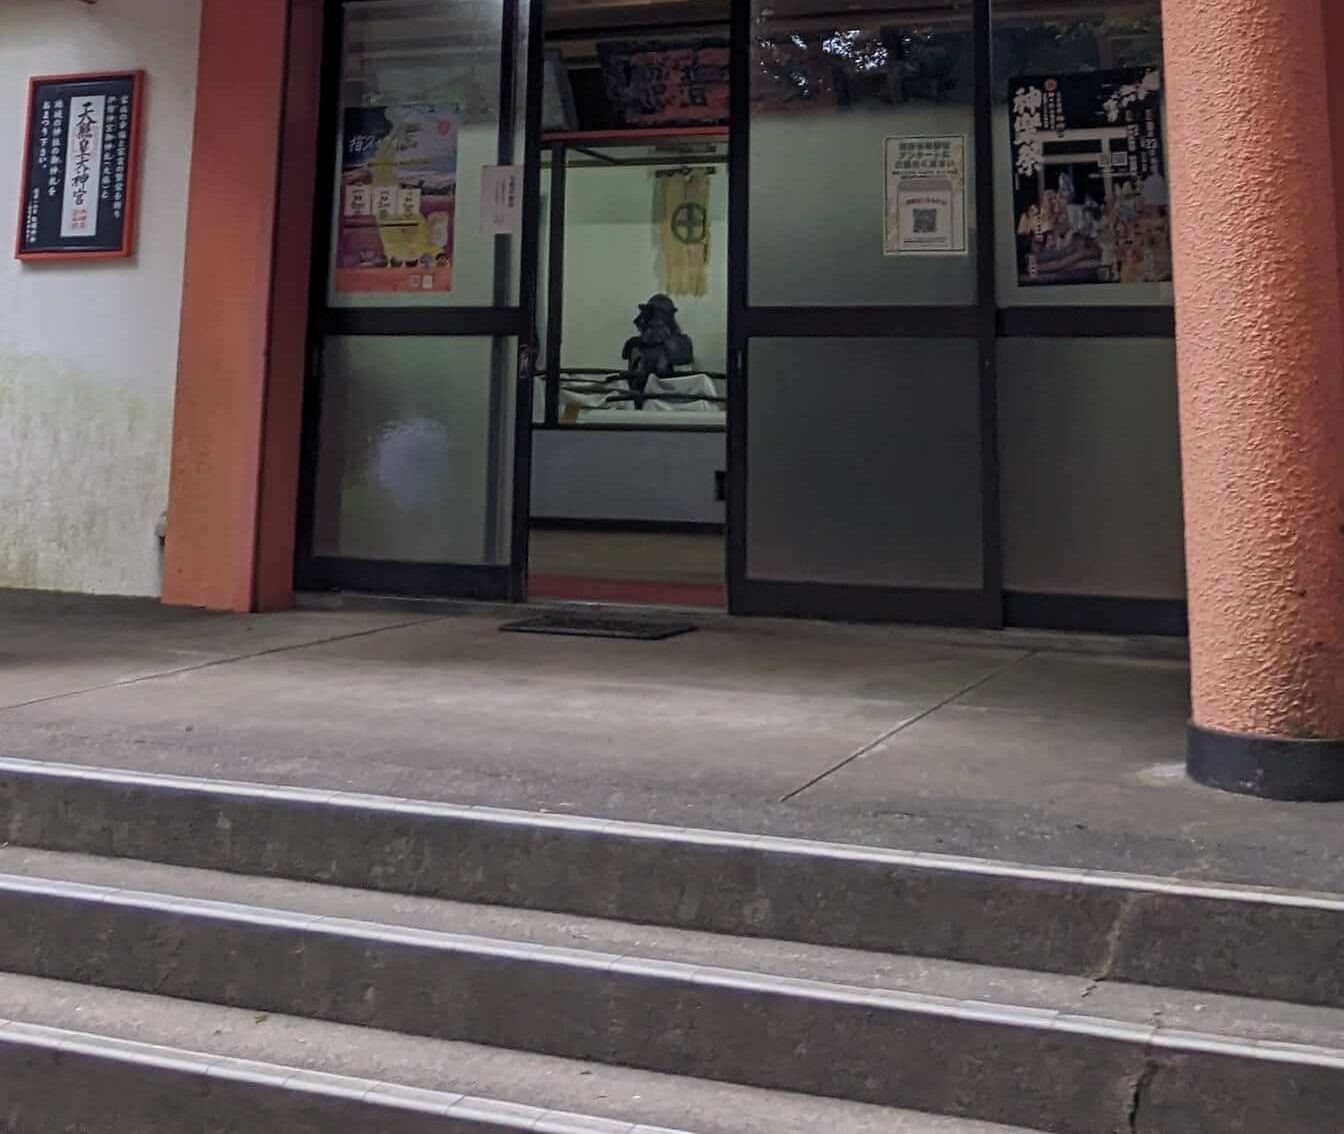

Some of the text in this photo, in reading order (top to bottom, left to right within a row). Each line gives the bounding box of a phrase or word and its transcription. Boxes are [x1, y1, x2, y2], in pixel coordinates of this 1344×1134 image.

[72, 101, 97, 205] 天照皇大神宮
